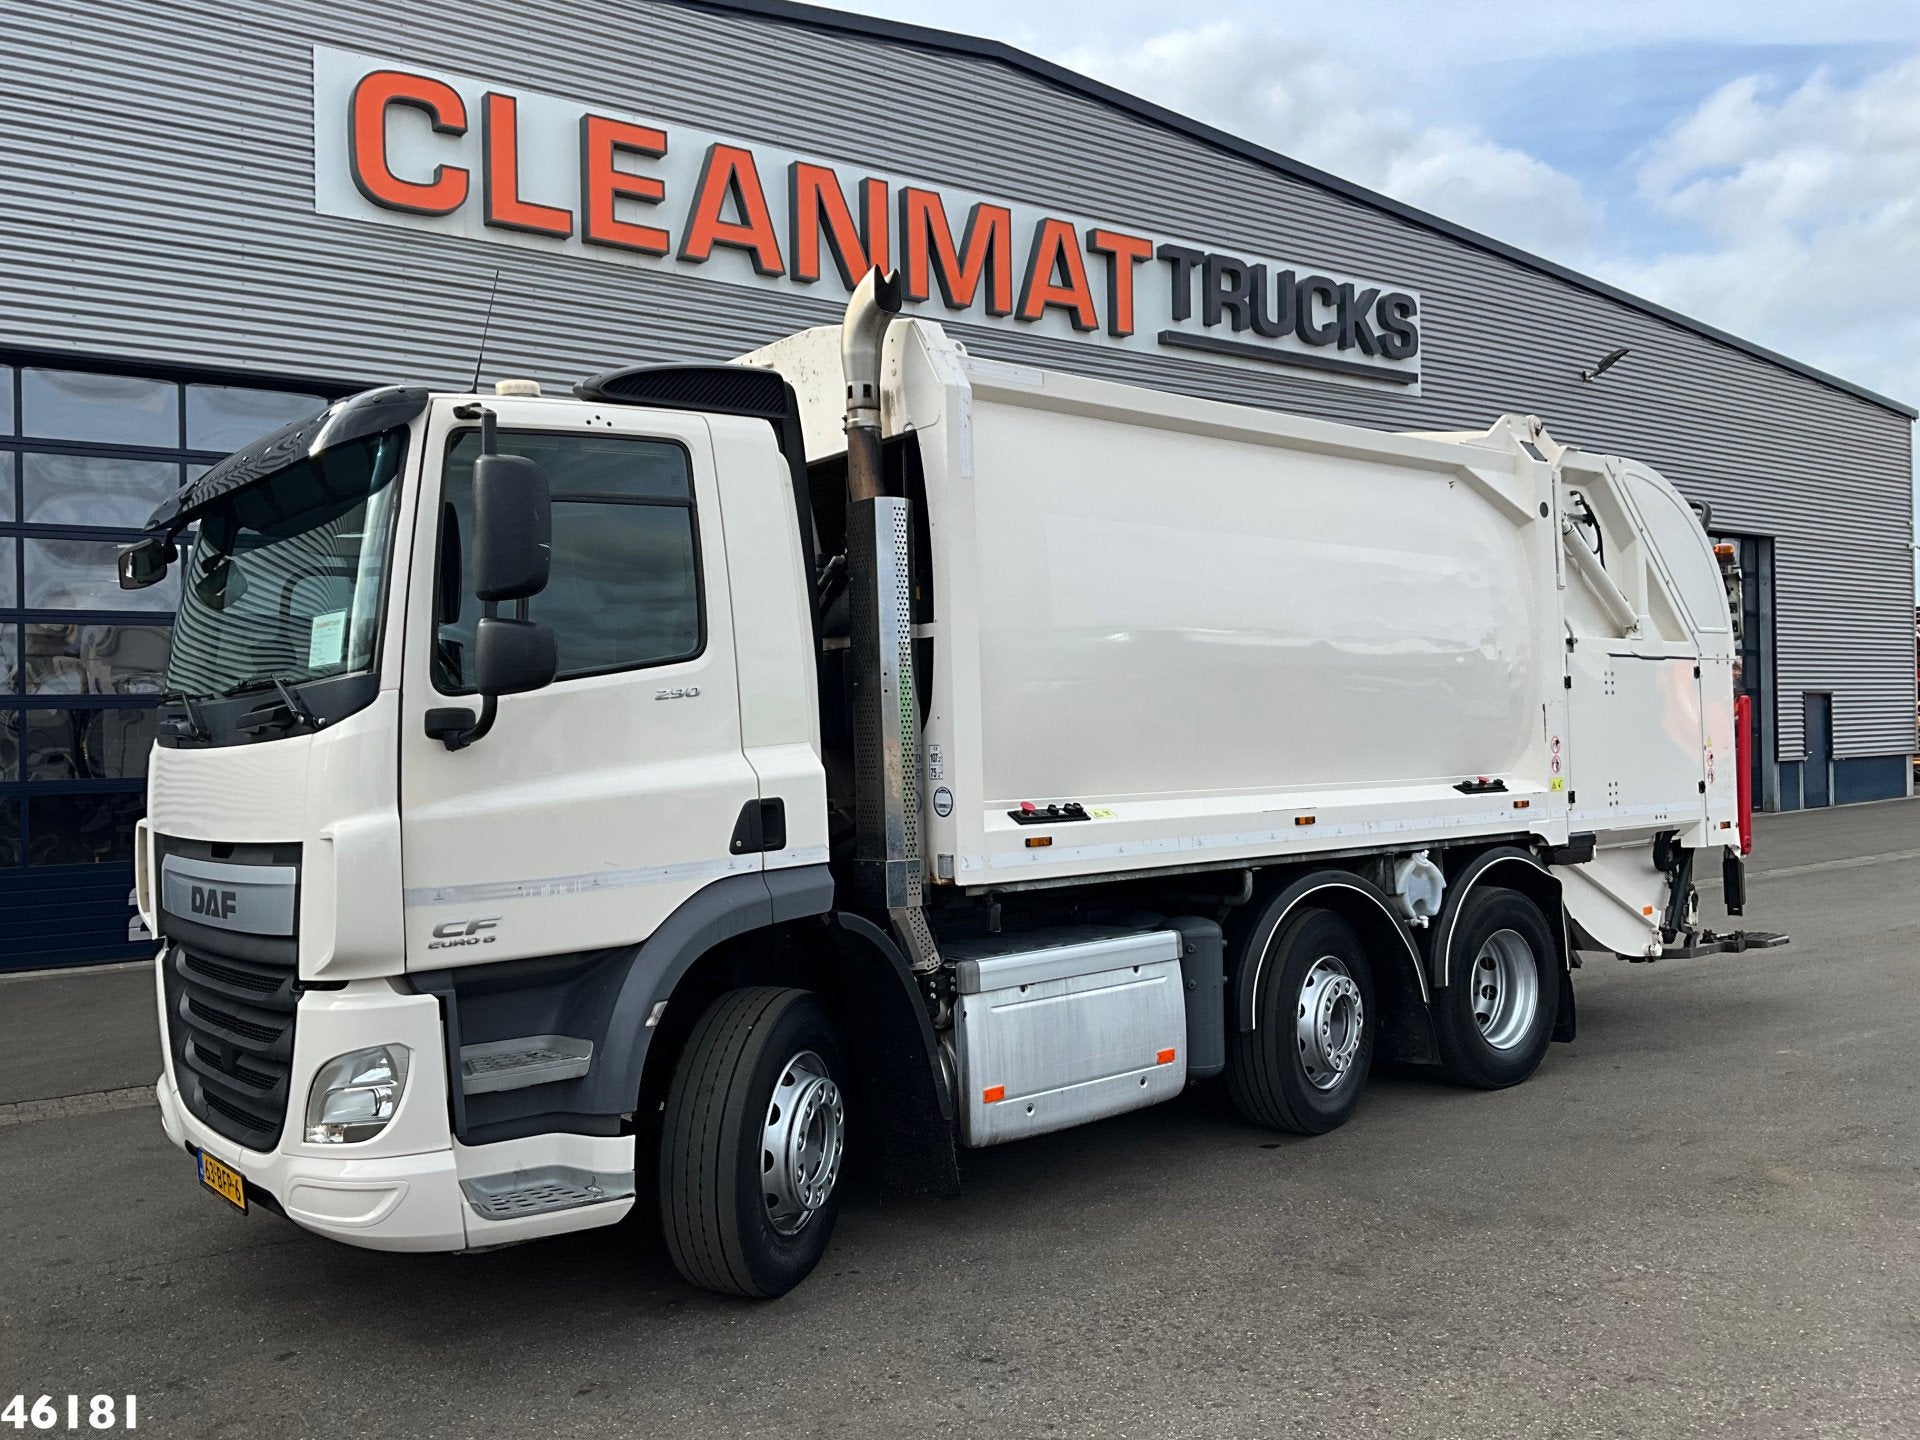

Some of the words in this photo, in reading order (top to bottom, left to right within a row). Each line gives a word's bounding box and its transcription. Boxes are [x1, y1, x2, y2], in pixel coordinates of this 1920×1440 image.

[348, 70, 1153, 337] CLEANMAT
[1157, 243, 1419, 360] TRUCKS
[655, 687, 701, 701] 290
[191, 885, 237, 919] DAF
[432, 914, 503, 938] CF
[428, 938, 480, 949] EURO
